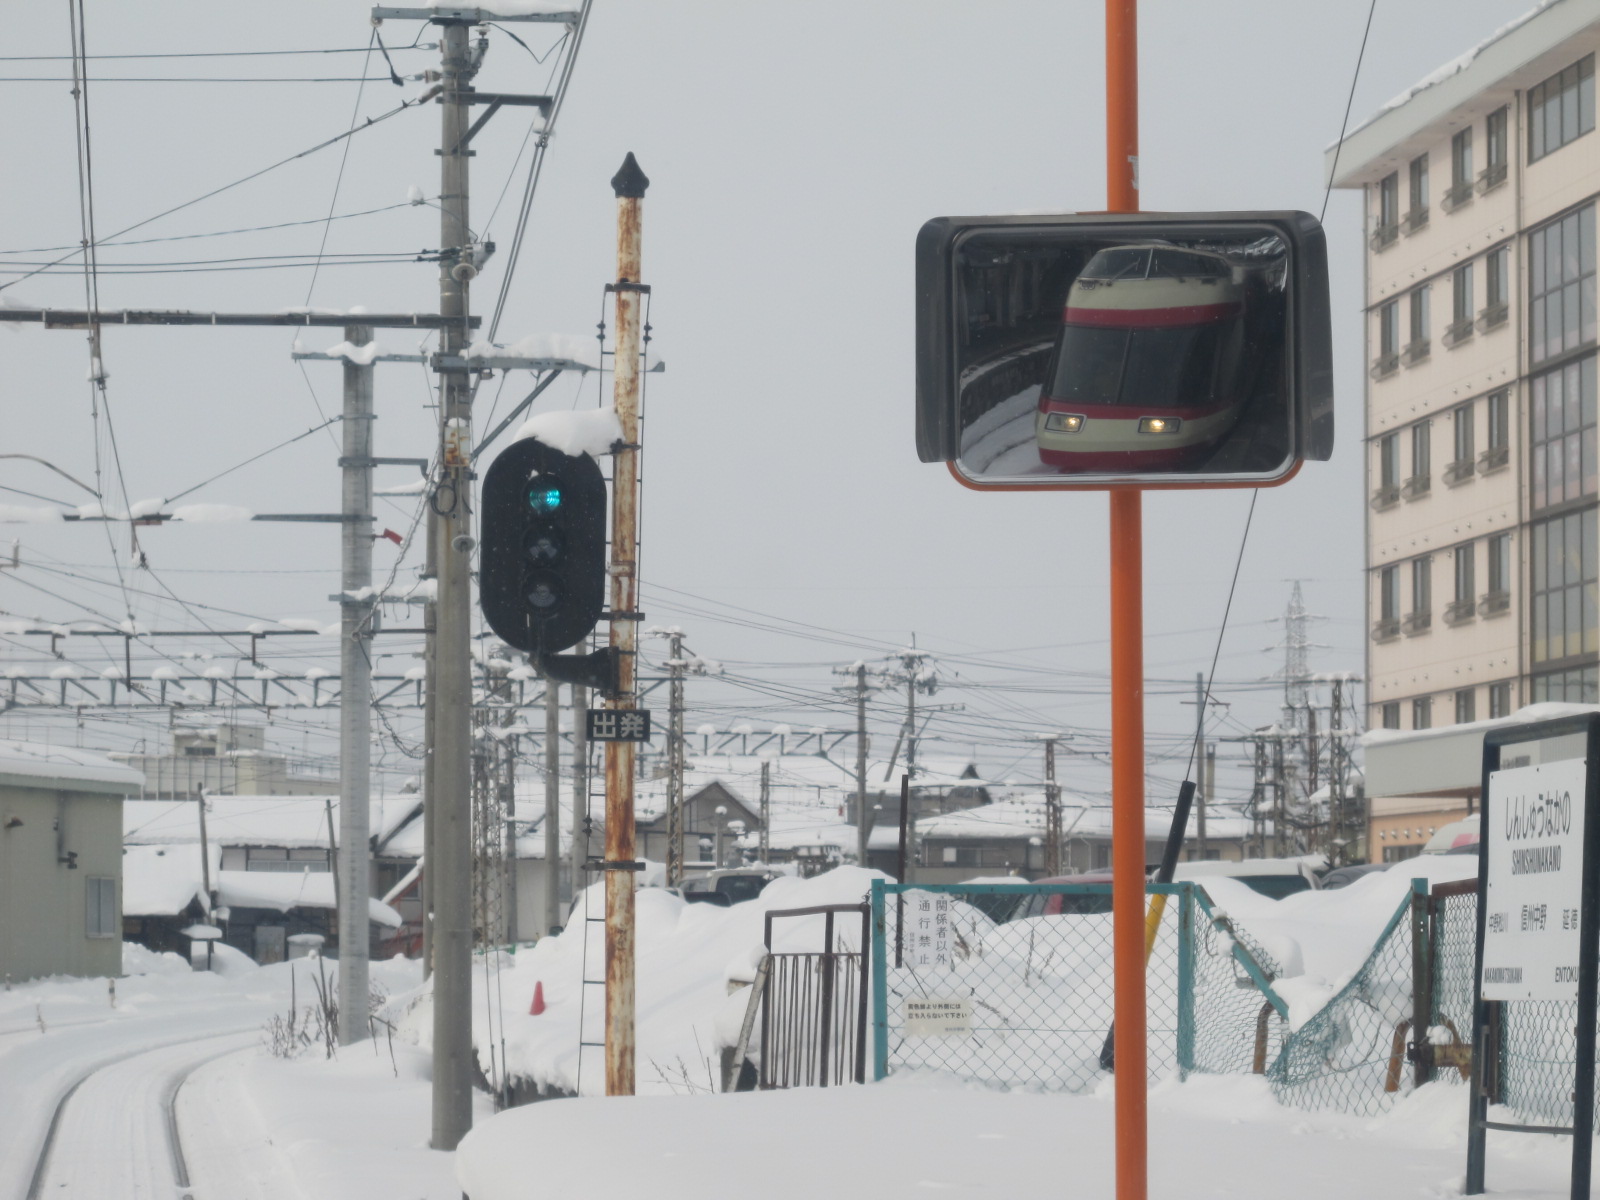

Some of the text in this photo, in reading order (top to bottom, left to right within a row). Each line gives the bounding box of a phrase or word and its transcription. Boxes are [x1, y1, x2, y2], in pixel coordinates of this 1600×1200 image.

[593, 712, 645, 738] 出発
[1505, 789, 1571, 841] しんしゅうなかの
[1512, 845, 1562, 875] SHINSHUNAKANO
[919, 900, 931, 965] 通行禁止
[936, 900, 948, 965] 関係者以外
[1521, 902, 1547, 931] 信州中野
